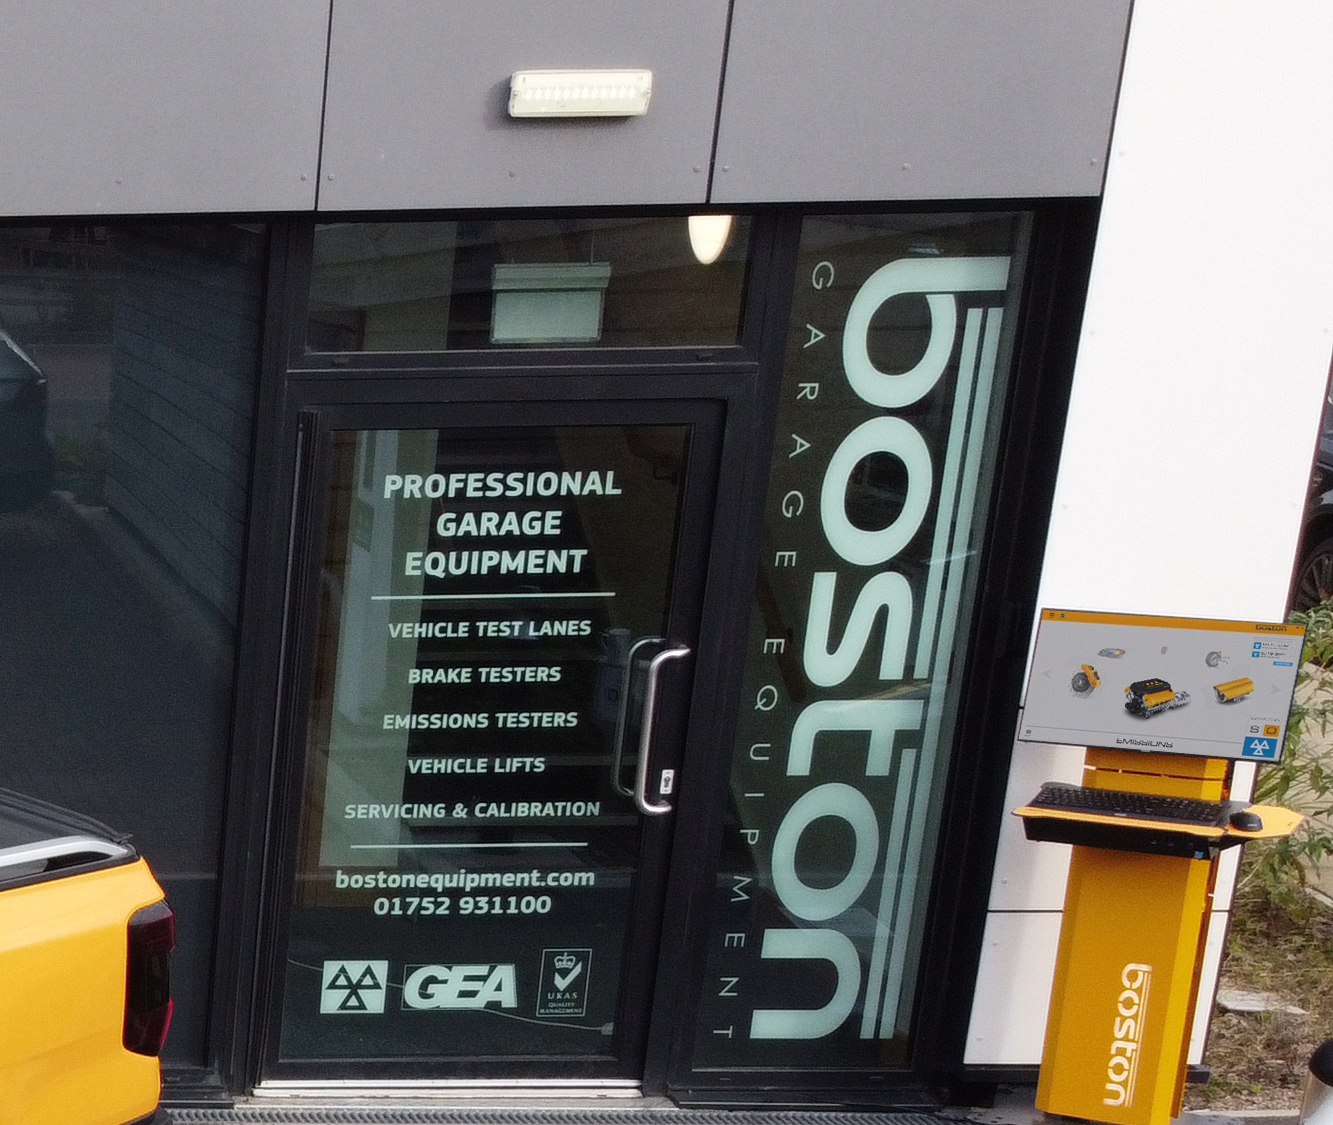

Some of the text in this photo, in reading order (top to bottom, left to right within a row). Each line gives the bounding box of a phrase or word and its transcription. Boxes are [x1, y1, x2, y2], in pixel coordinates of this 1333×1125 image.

[384, 471, 622, 499] PROFESSIONAL
[437, 511, 562, 537] GARAGE
[405, 549, 588, 578] EQUIPMENT
[389, 620, 592, 638] VEHICLE TEST LANES
[713, 261, 834, 1038] GARAGE EQUIPMENT
[749, 256, 1011, 1039] boston
[408, 667, 561, 684] BRAKE TESTERS
[383, 712, 578, 730] EMISSIONS TESTERS
[1116, 737, 1174, 749] EMISSIONS
[408, 757, 545, 774] VEHICLE LIFTS
[344, 801, 600, 819] SERVICING & CALIBRATION
[335, 869, 595, 892] bostonequipment.com
[374, 896, 552, 915] 01752 931100
[404, 965, 517, 1009] GEA
[547, 992, 578, 1000] UKAS
[1103, 963, 1152, 1107] boston
